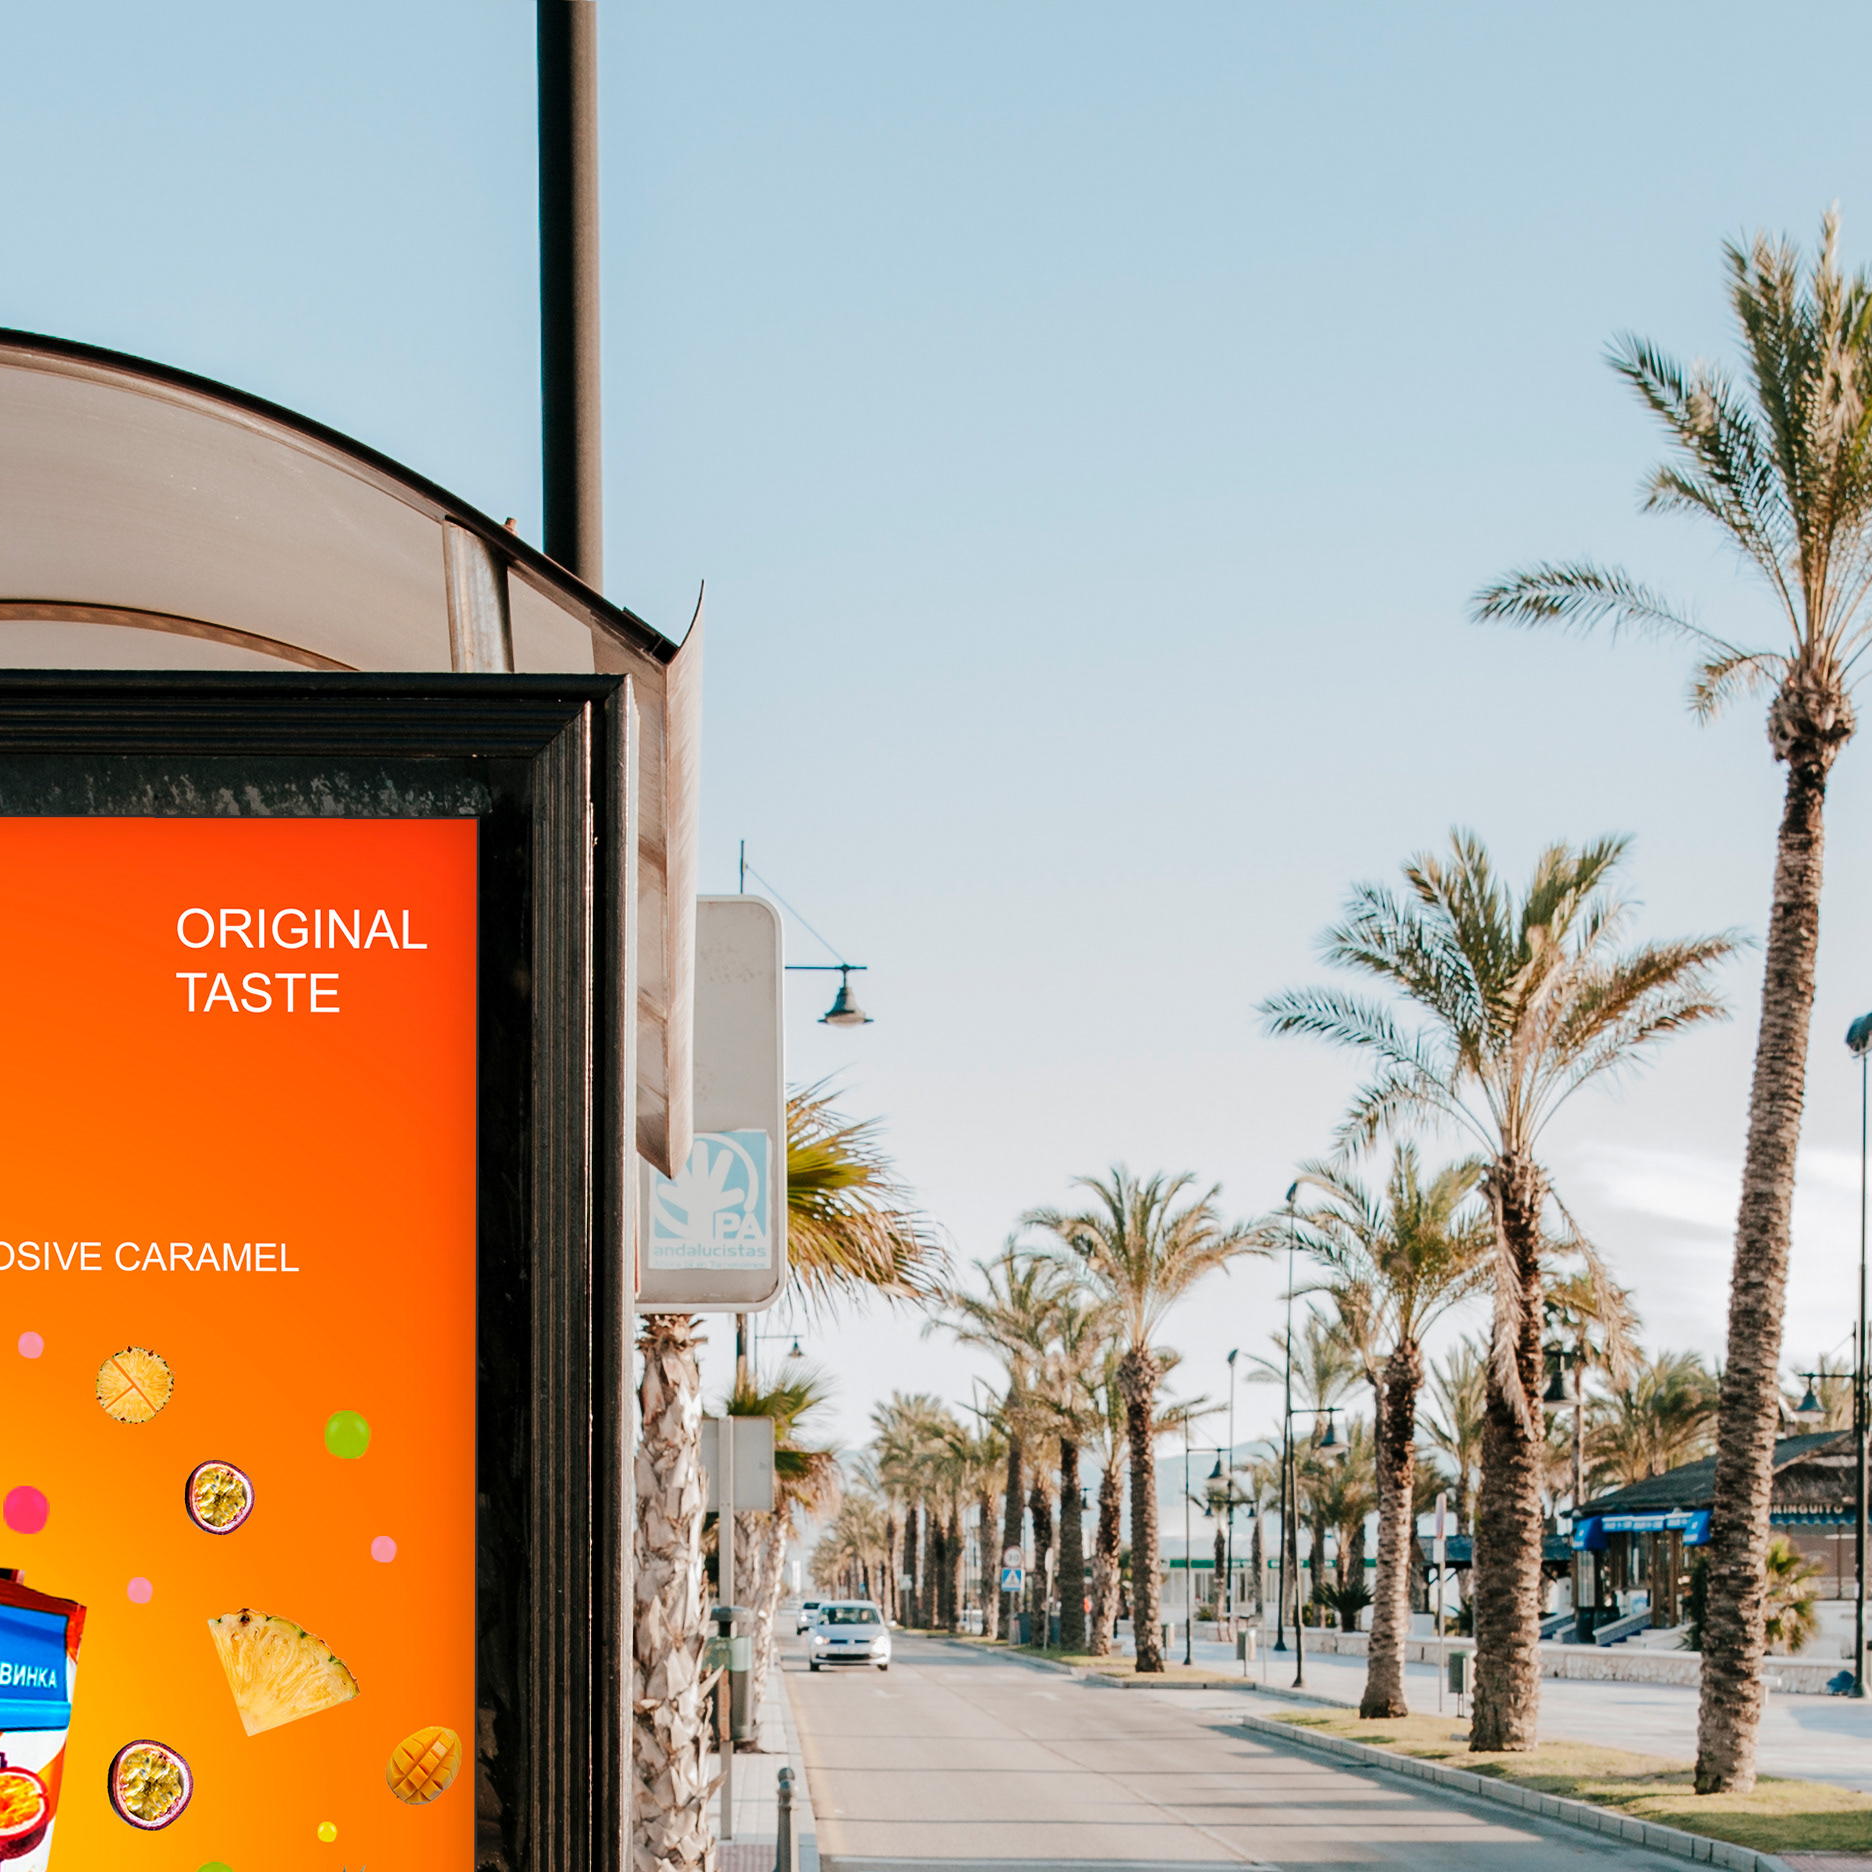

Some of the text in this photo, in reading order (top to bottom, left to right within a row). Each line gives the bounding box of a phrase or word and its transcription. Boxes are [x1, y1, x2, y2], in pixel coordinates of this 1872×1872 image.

[176, 907, 428, 950] ORIGINAL
[176, 972, 340, 1013] TASTE
[715, 1211, 766, 1240] PA
[115, 1241, 300, 1272] CARAMEL
[654, 1243, 766, 1257] andalucistas
